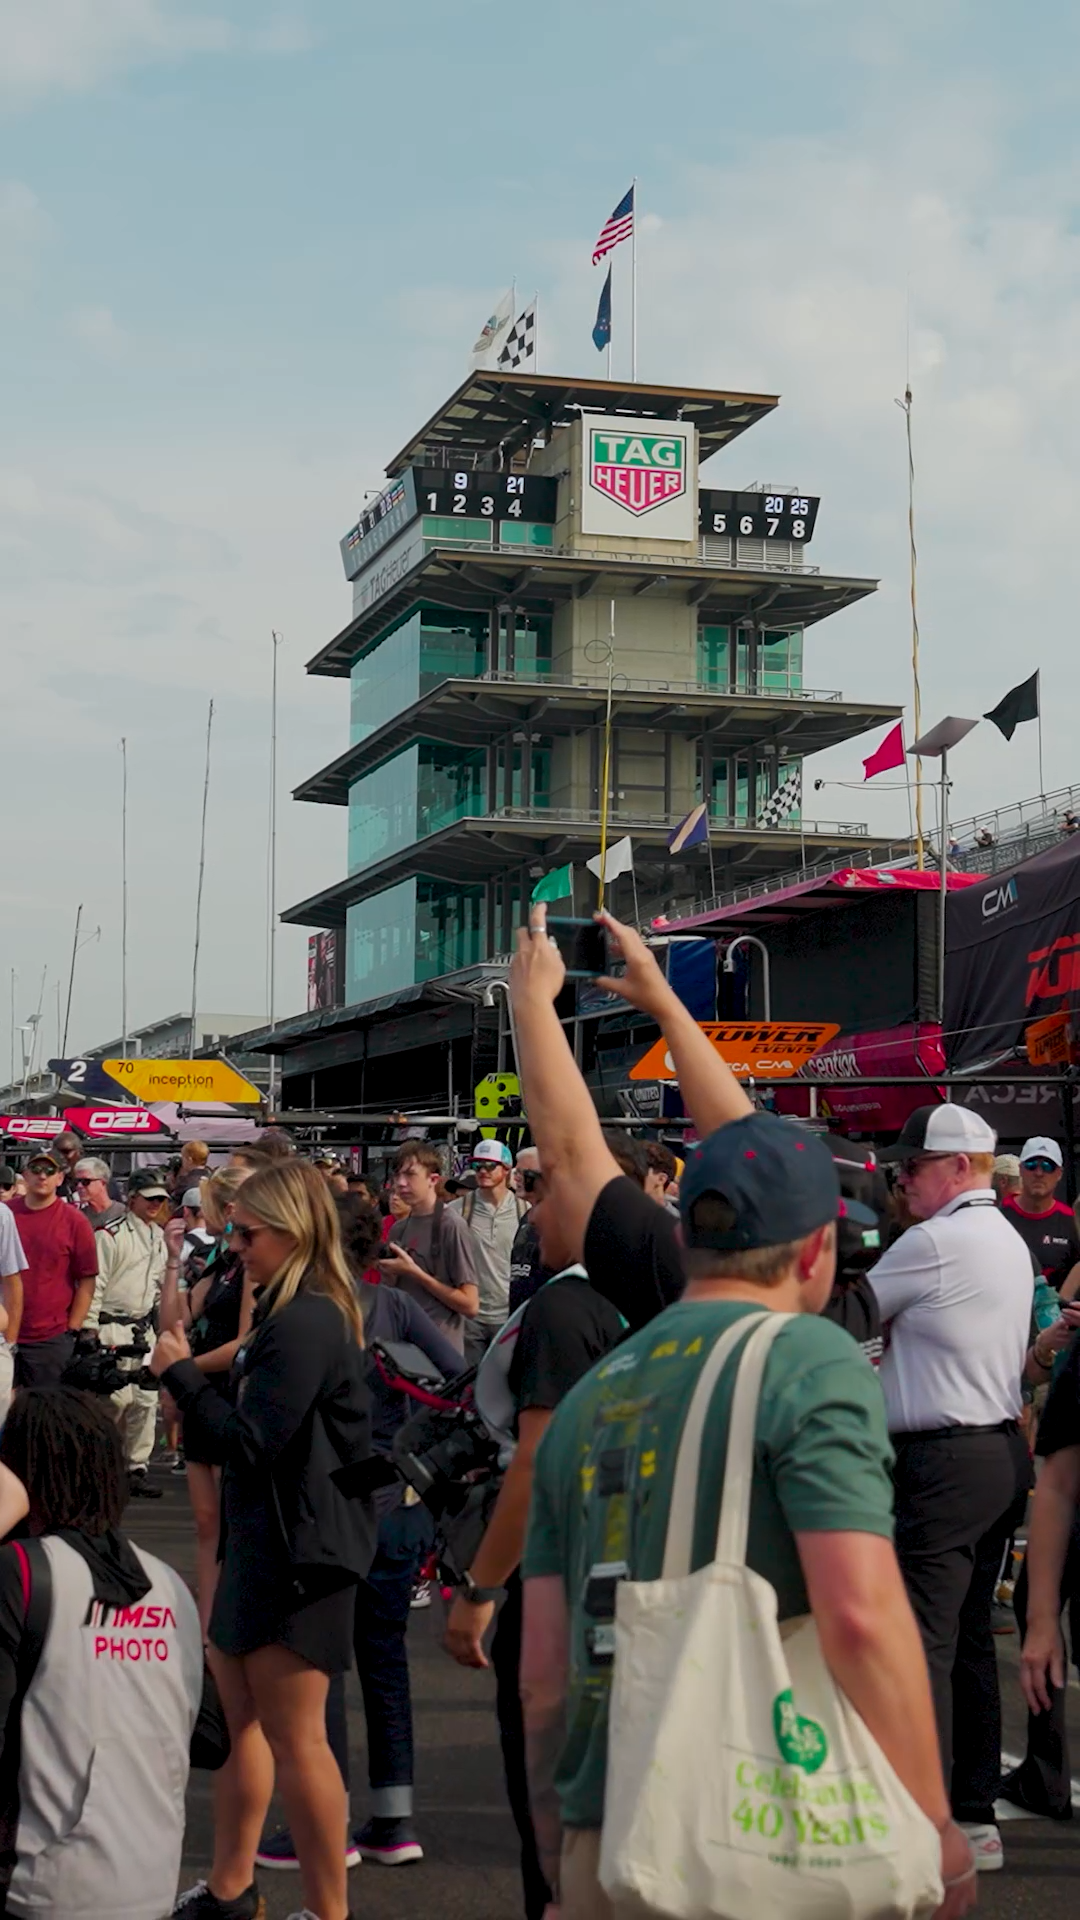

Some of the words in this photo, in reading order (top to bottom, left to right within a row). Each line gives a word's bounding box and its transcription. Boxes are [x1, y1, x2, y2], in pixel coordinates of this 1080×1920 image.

[599, 436, 676, 466] TAG
[454, 472, 468, 490] 9
[506, 476, 525, 494] 21
[596, 467, 680, 509] HEUER
[427, 492, 438, 511] 1
[452, 494, 467, 513] 2
[480, 496, 495, 515] 3
[507, 499, 522, 517] 4
[765, 496, 784, 514] 20
[790, 498, 809, 515] 25
[713, 514, 727, 533] 5
[740, 516, 753, 535] 6
[766, 518, 780, 536] 7
[792, 520, 806, 538] 8
[701, 1025, 826, 1042] TOWER
[750, 1043, 819, 1053] EVENTS
[67, 1061, 88, 1082] 2
[117, 1062, 134, 1073] 70
[148, 1074, 214, 1088] inception
[112, 1605, 177, 1628] IMSA
[95, 1636, 169, 1662] PHOTO
[732, 1798, 785, 1839] 40
[791, 1806, 890, 1846] Years
